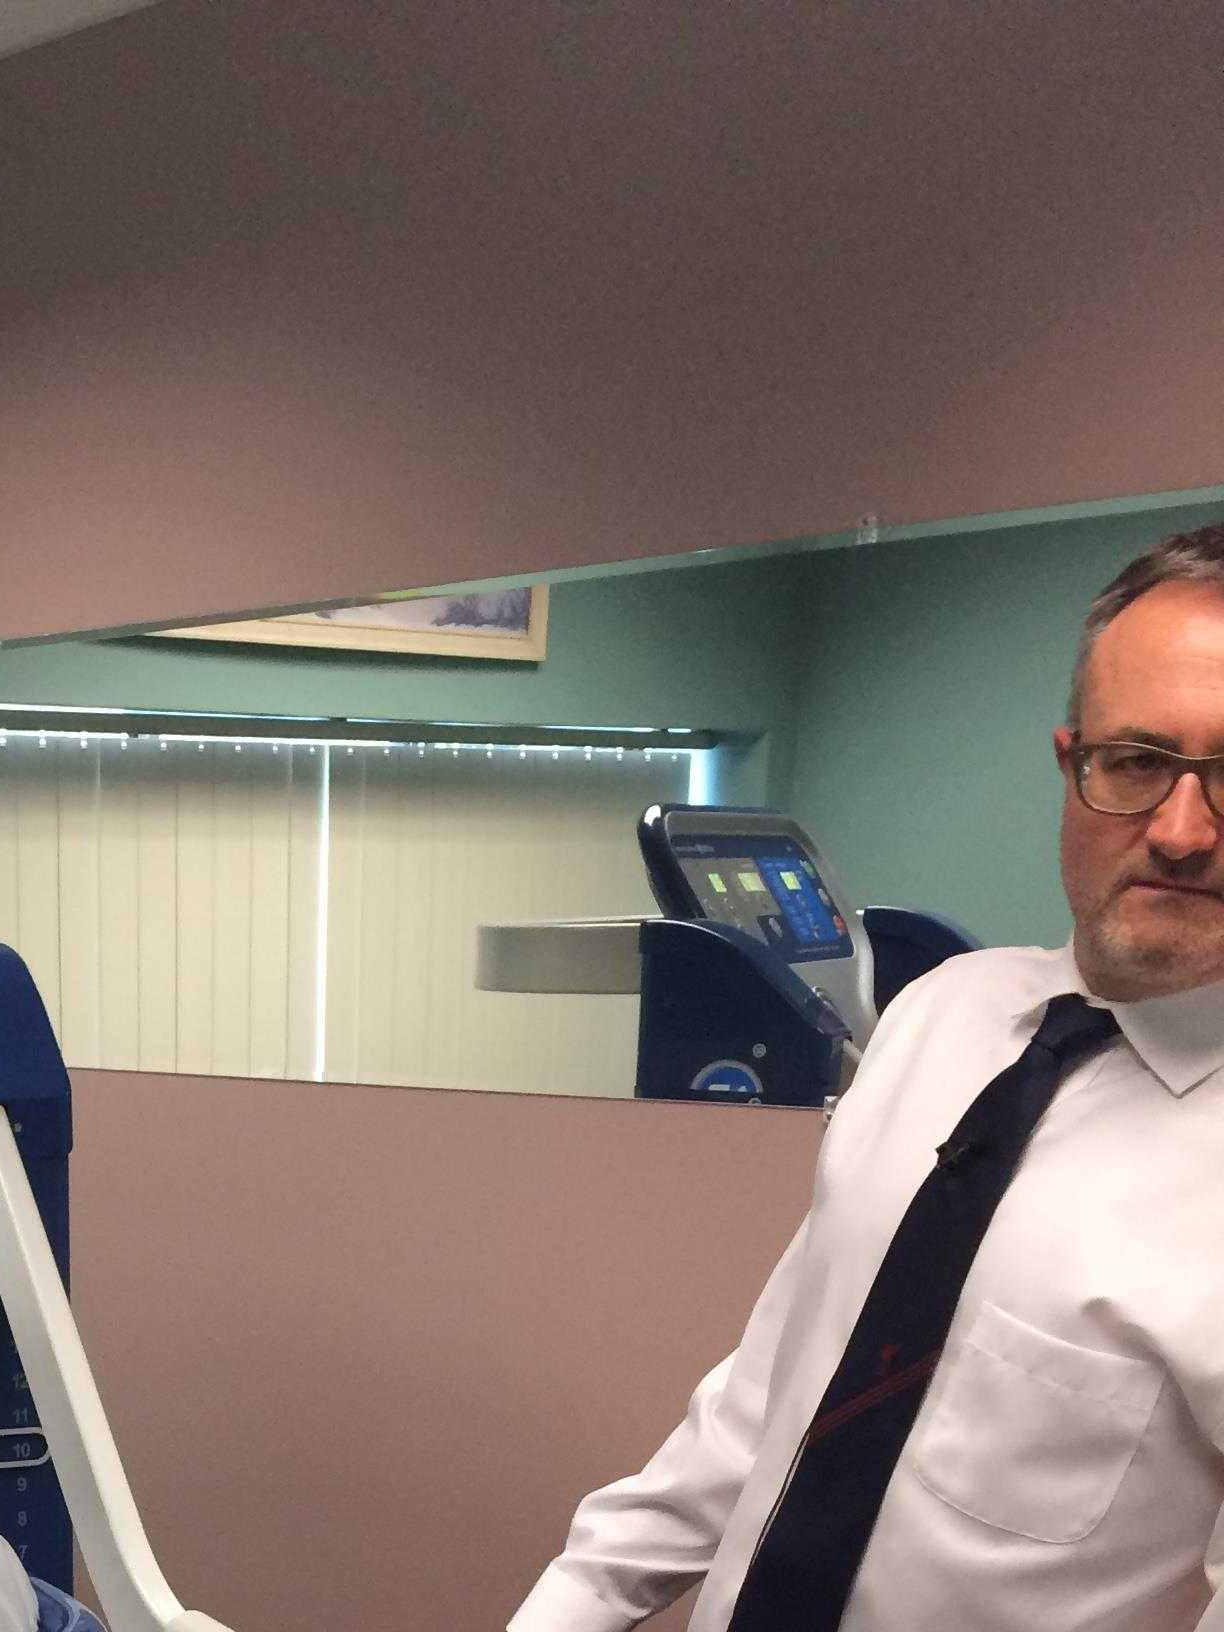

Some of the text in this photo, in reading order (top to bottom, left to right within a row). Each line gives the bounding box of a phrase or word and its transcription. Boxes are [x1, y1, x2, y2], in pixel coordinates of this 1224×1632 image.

[12, 1407, 29, 1424] 11
[13, 1442, 31, 1458] 10
[16, 1476, 28, 1492] 9
[17, 1510, 28, 1526] 8
